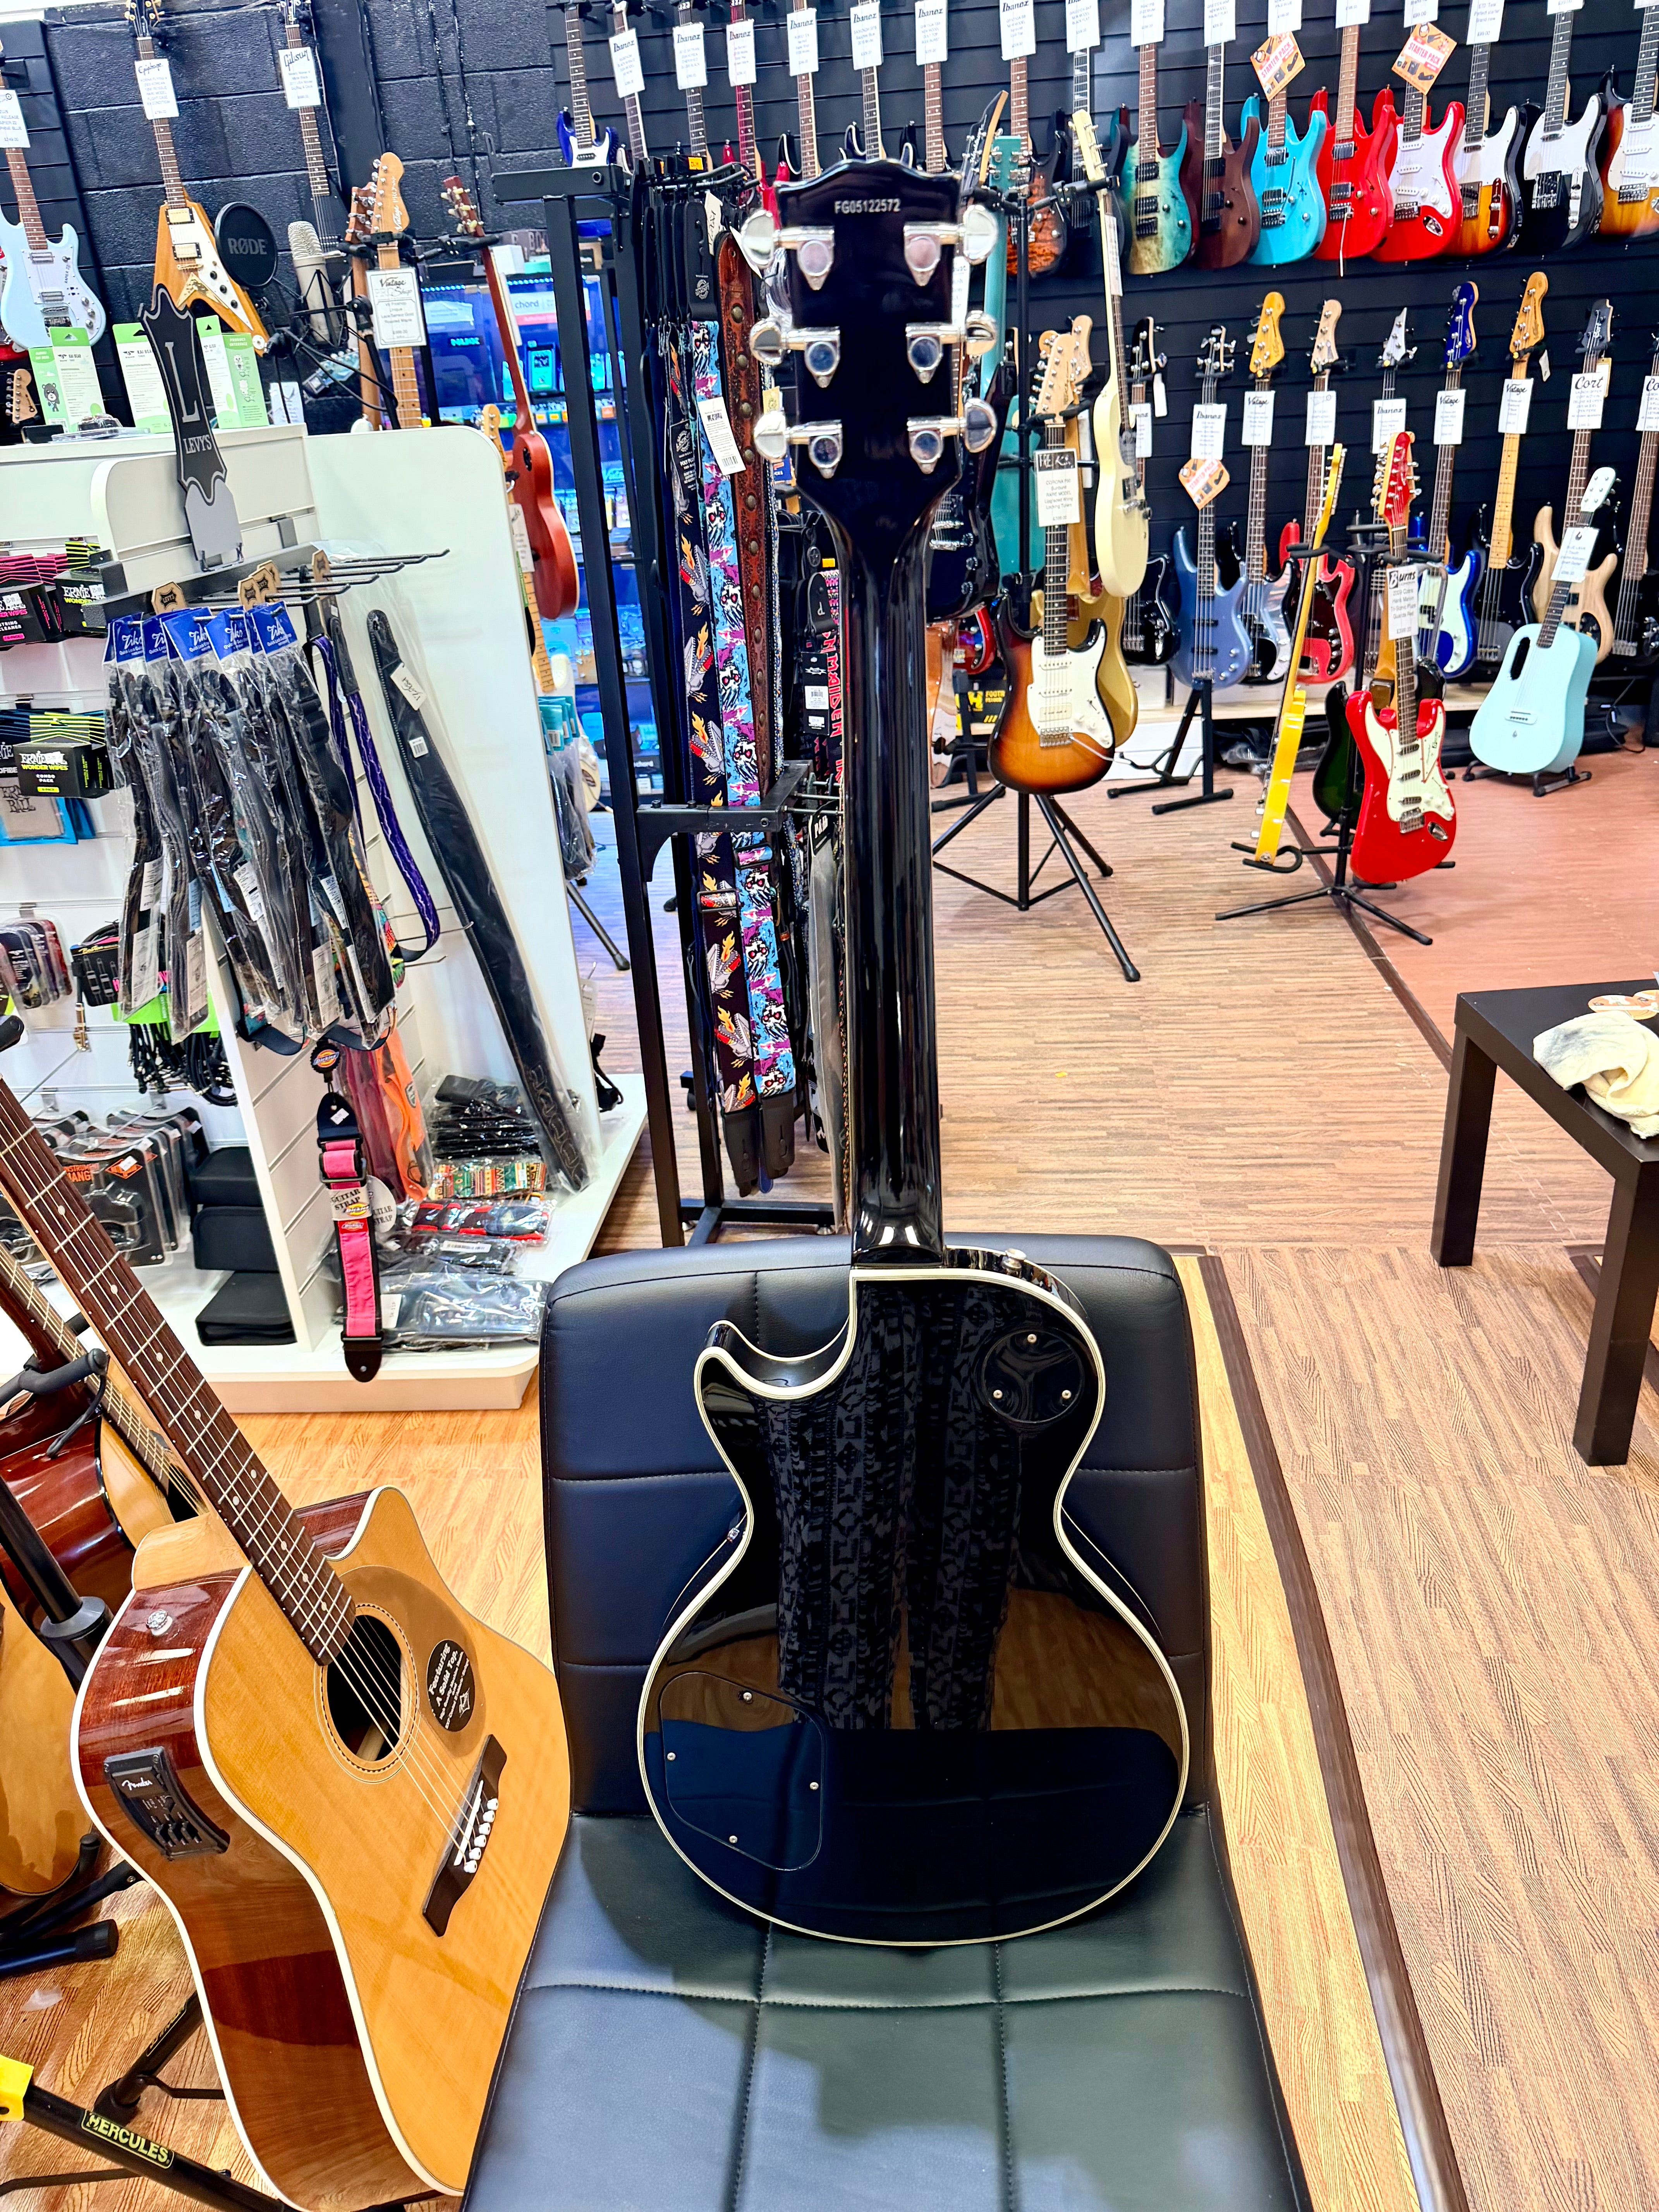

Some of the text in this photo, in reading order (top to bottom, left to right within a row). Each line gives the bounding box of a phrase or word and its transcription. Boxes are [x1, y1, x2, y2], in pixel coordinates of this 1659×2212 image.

[919, 8, 943, 18] Ibanez
[1002, 1, 1029, 12] Ibanez
[790, 19, 814, 30] Ibanez
[854, 13, 877, 24] Ibanez
[677, 34, 701, 43] Ibanez
[730, 31, 751, 41] Ibanez
[614, 40, 635, 52] Ibanez
[283, 49, 310, 72] Gibson
[1261, 42, 1291, 78] STARTER PACK
[1408, 42, 1441, 65] STARTER PACK
[834, 198, 902, 214] FG05122572
[380, 277, 406, 288] Vintage
[515, 299, 539, 309] chord
[1575, 376, 1604, 390] Cort
[1196, 411, 1222, 419] Ibanez
[1377, 406, 1403, 415] Ibanez
[183, 434, 212, 454] LEVY'S
[1389, 570, 1416, 589] Burns
[62, 584, 91, 598] ERNIE
[826, 658, 843, 738] MAIDEN
[19, 750, 46, 765] ERNIE
[312, 1052, 340, 1066] Dickies
[331, 1188, 361, 1203] GUITAR
[334, 1196, 361, 1211] STRAP
[344, 1203, 370, 1214] Dickies
[428, 1643, 450, 1695] Featuring
[436, 1650, 458, 1707] A Solid Top,
[444, 1687, 452, 1707] Quality
[122, 1777, 153, 1791] Fender
[86, 2113, 168, 2163] HERCULES
